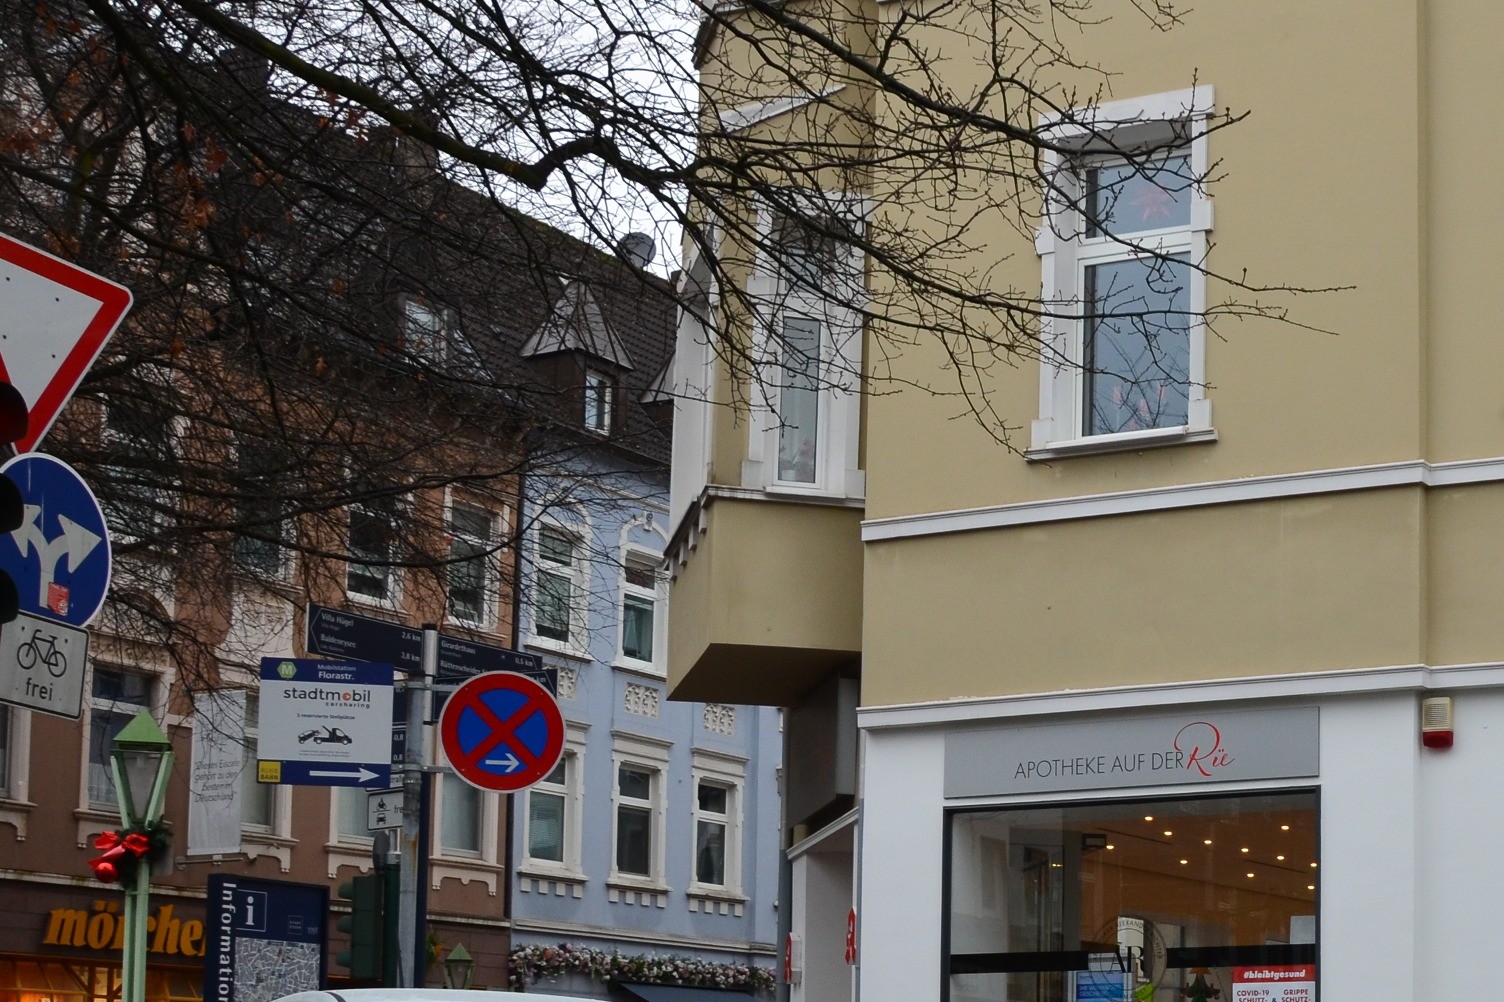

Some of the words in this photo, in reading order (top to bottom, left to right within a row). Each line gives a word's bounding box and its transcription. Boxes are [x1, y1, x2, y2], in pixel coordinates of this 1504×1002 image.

[412, 633, 421, 641] km
[411, 653, 421, 661] km
[524, 658, 534, 667] km
[317, 664, 357, 672] Mobilstation
[318, 671, 355, 681] Florastr.
[25, 677, 54, 701] frei
[283, 687, 371, 703] stadtmobil
[325, 701, 371, 710] carsharing
[1014, 756, 1106, 779] APOTHEKE
[1111, 753, 1145, 773] AUF
[1151, 751, 1184, 770] DER
[394, 805, 404, 814] fre
[1243, 969, 1306, 980] #bleibtgesund
